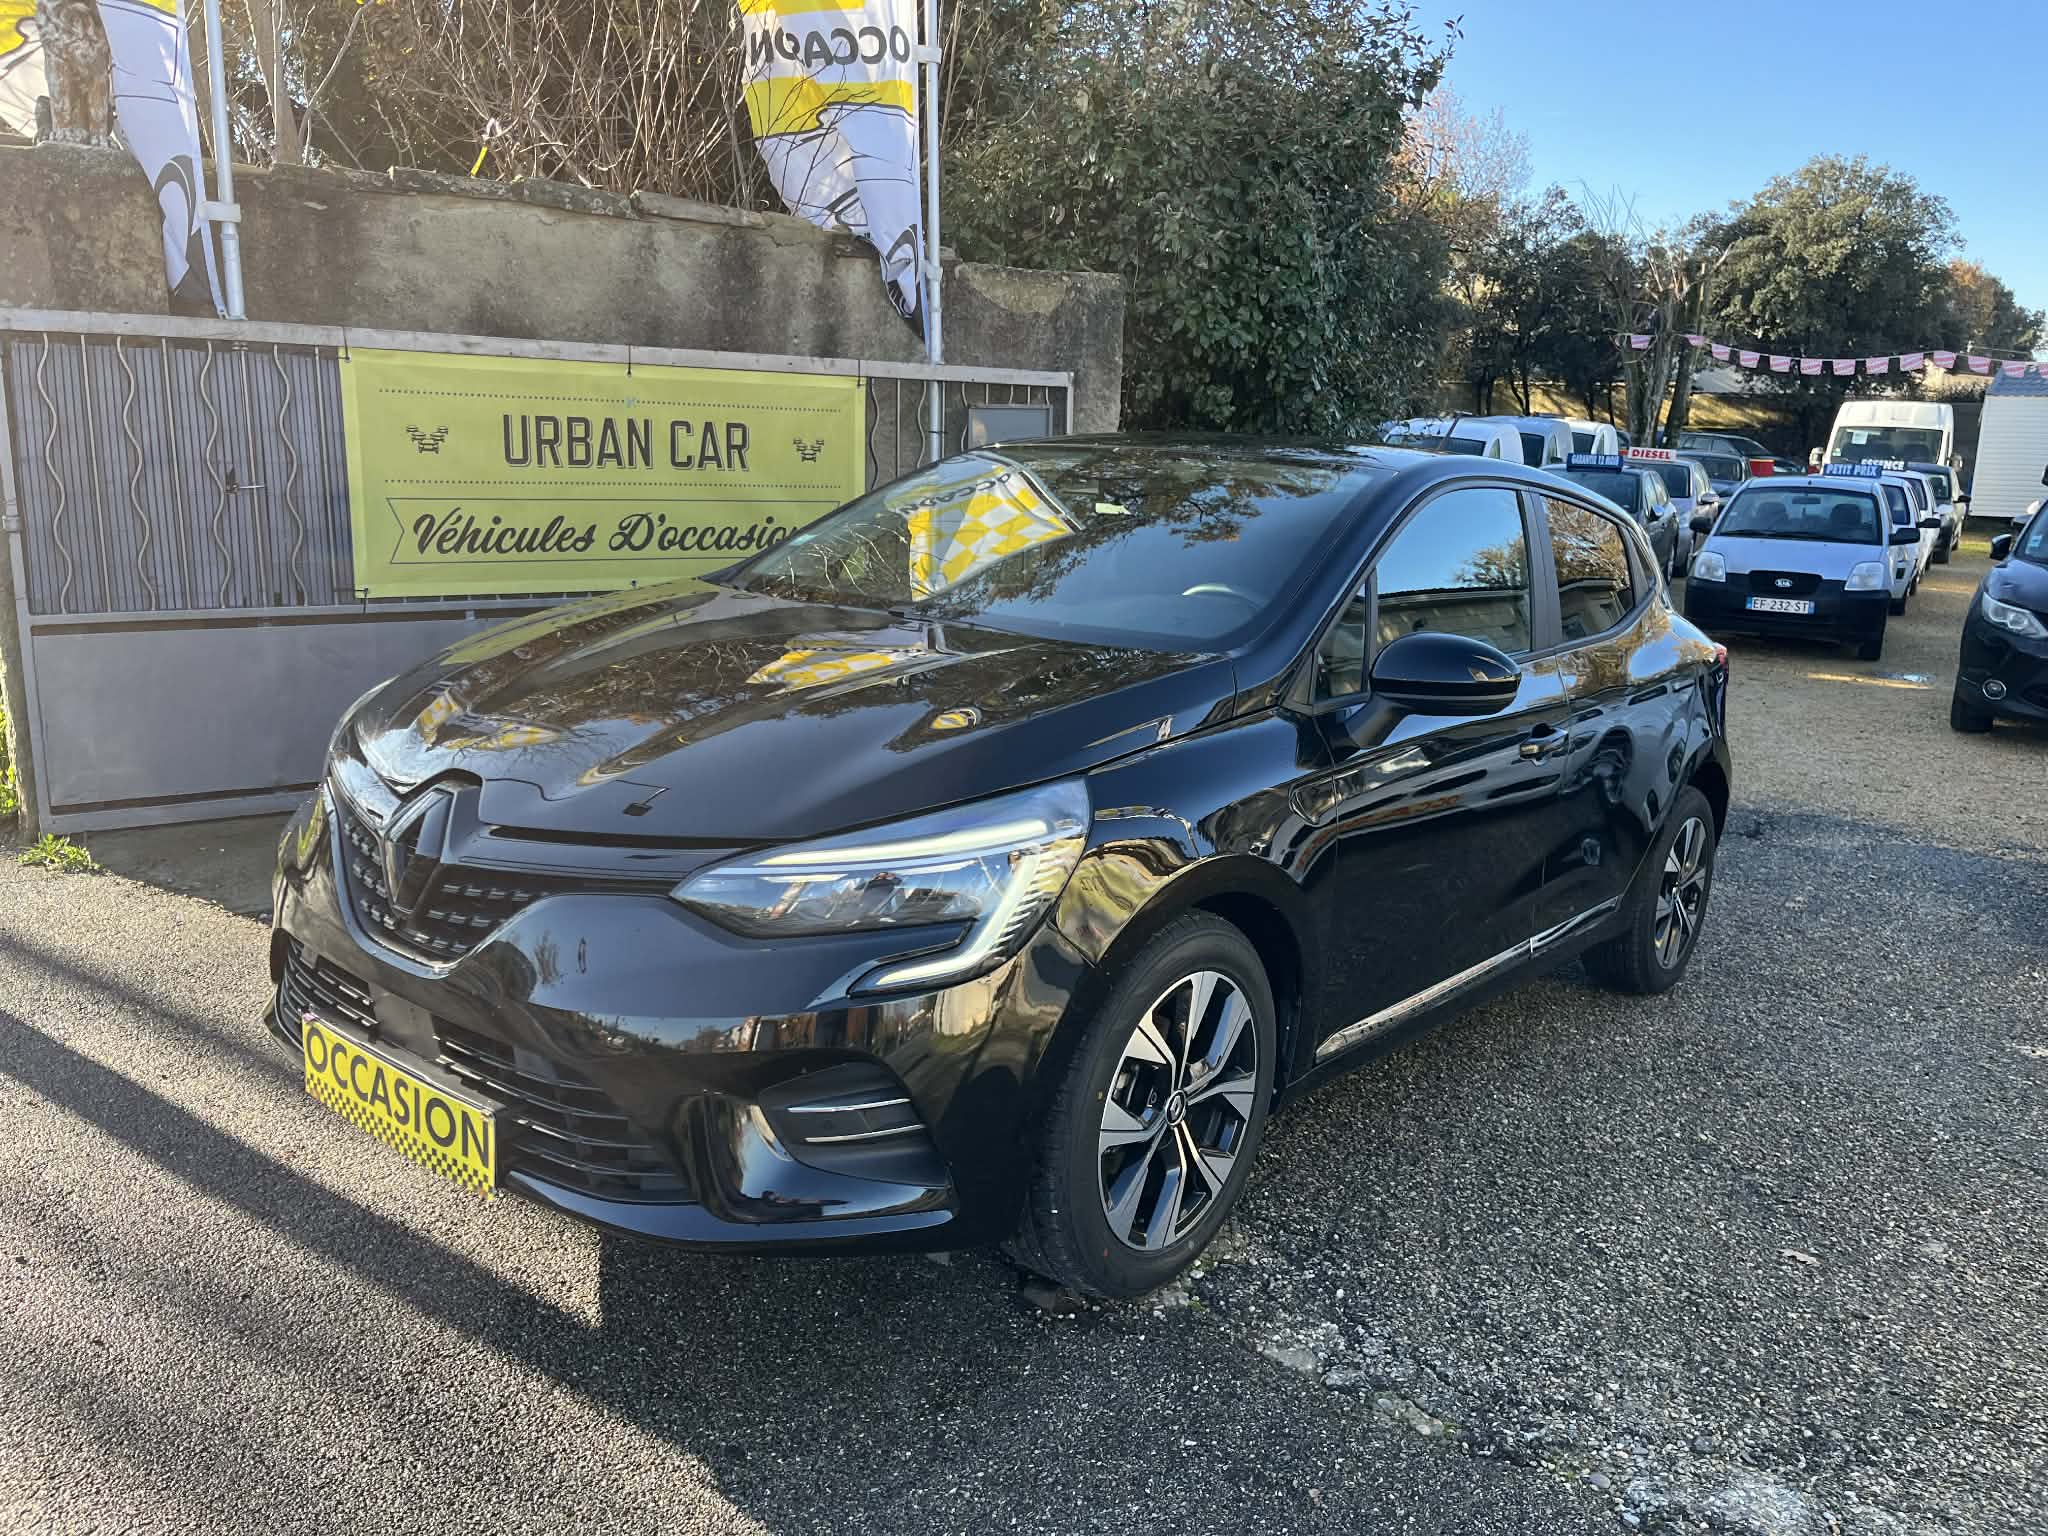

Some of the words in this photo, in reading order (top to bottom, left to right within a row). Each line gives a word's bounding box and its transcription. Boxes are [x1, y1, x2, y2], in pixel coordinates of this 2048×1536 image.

[503, 414, 653, 469] URBAN
[670, 420, 749, 472] CAR
[1632, 448, 1671, 460] DIESEL
[1826, 464, 1853, 475] PETIT
[1854, 465, 1877, 477] PRIX
[413, 507, 597, 555] Véhicules
[608, 512, 797, 551] D'occasio
[306, 1025, 490, 1169] OCCASION
